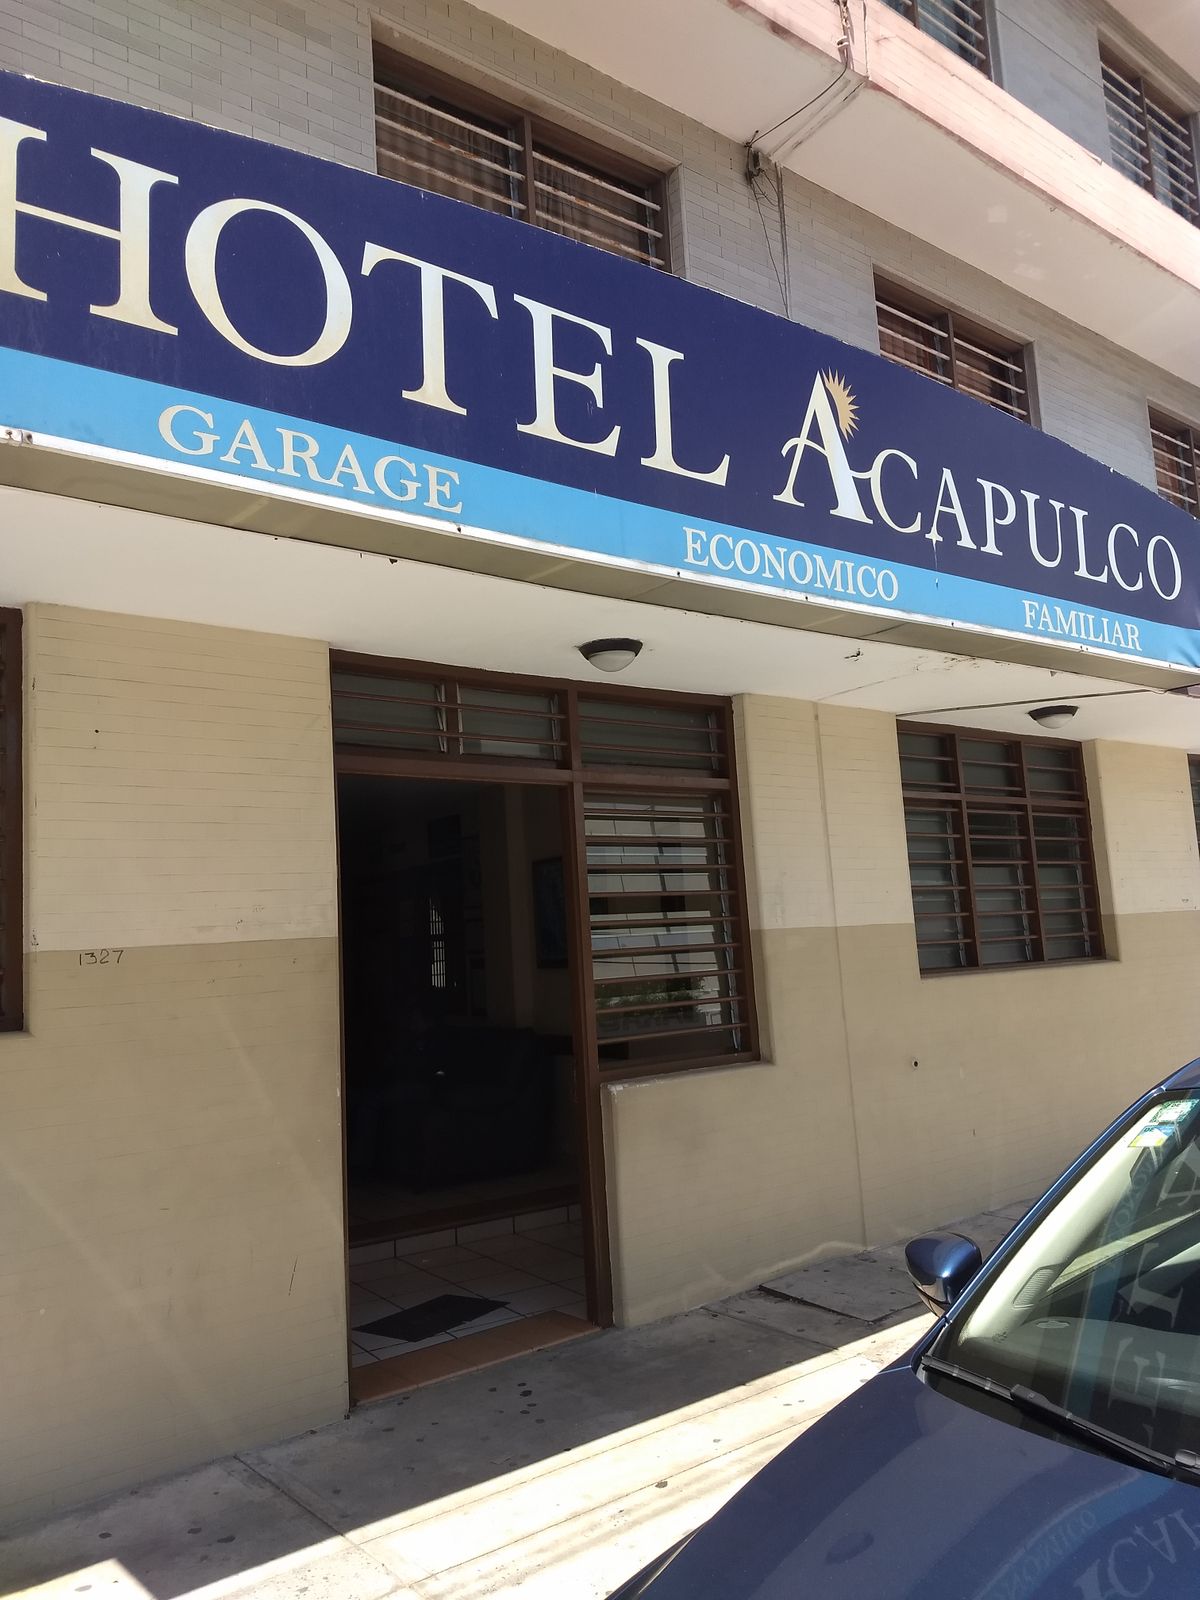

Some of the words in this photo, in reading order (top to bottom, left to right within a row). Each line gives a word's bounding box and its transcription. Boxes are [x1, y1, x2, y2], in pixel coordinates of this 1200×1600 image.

[0, 115, 730, 486] HOTEL
[772, 368, 1183, 601] ACAPULCO
[157, 404, 464, 514] GARAGE
[682, 527, 899, 601] ECONOMICO
[1023, 602, 1143, 652] FAMILIAR
[79, 949, 124, 966] 1327
